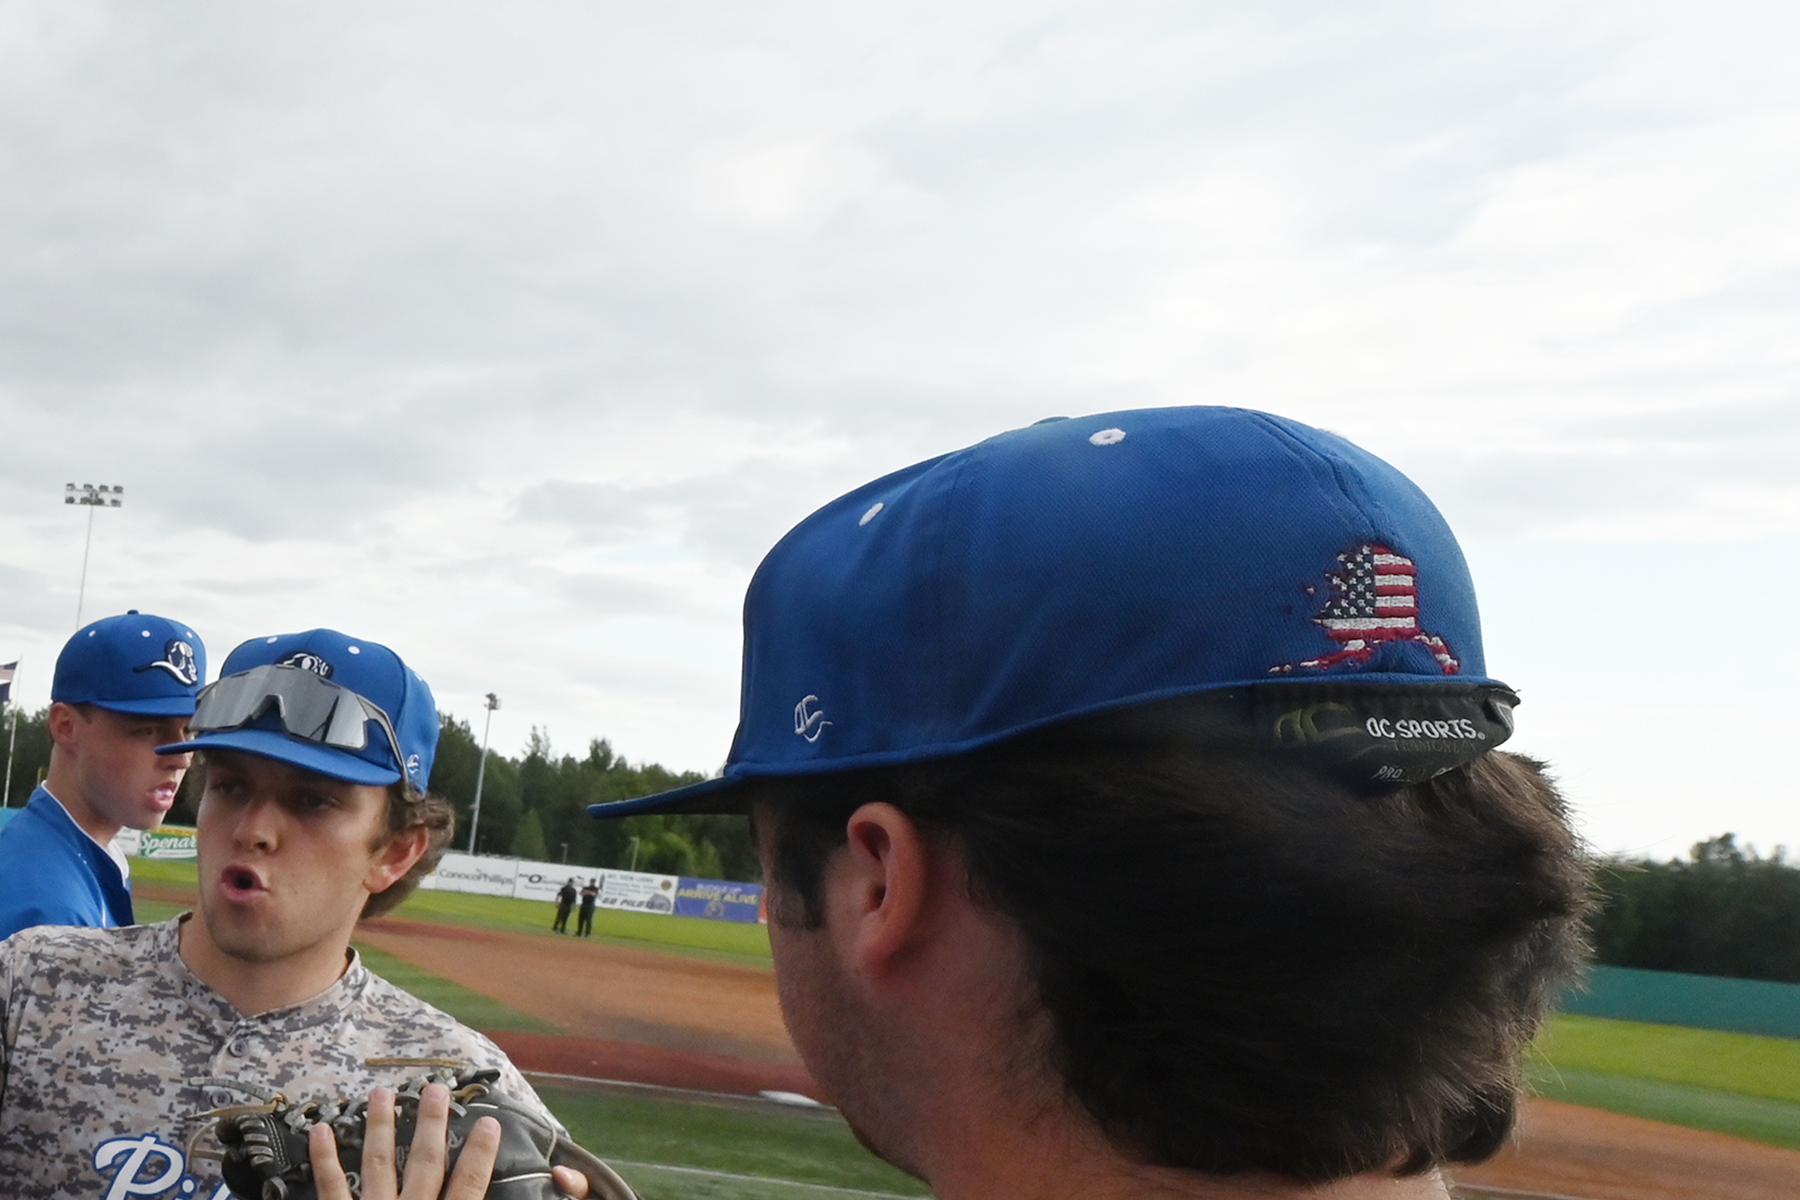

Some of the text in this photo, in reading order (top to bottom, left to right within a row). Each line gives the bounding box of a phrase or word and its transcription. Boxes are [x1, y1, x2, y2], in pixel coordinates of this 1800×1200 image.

[1365, 716, 1477, 740] OC SPORTS
[1370, 765, 1403, 780] PRO
[141, 832, 197, 857] Spenar
[439, 867, 513, 886] ConocoPhillips
